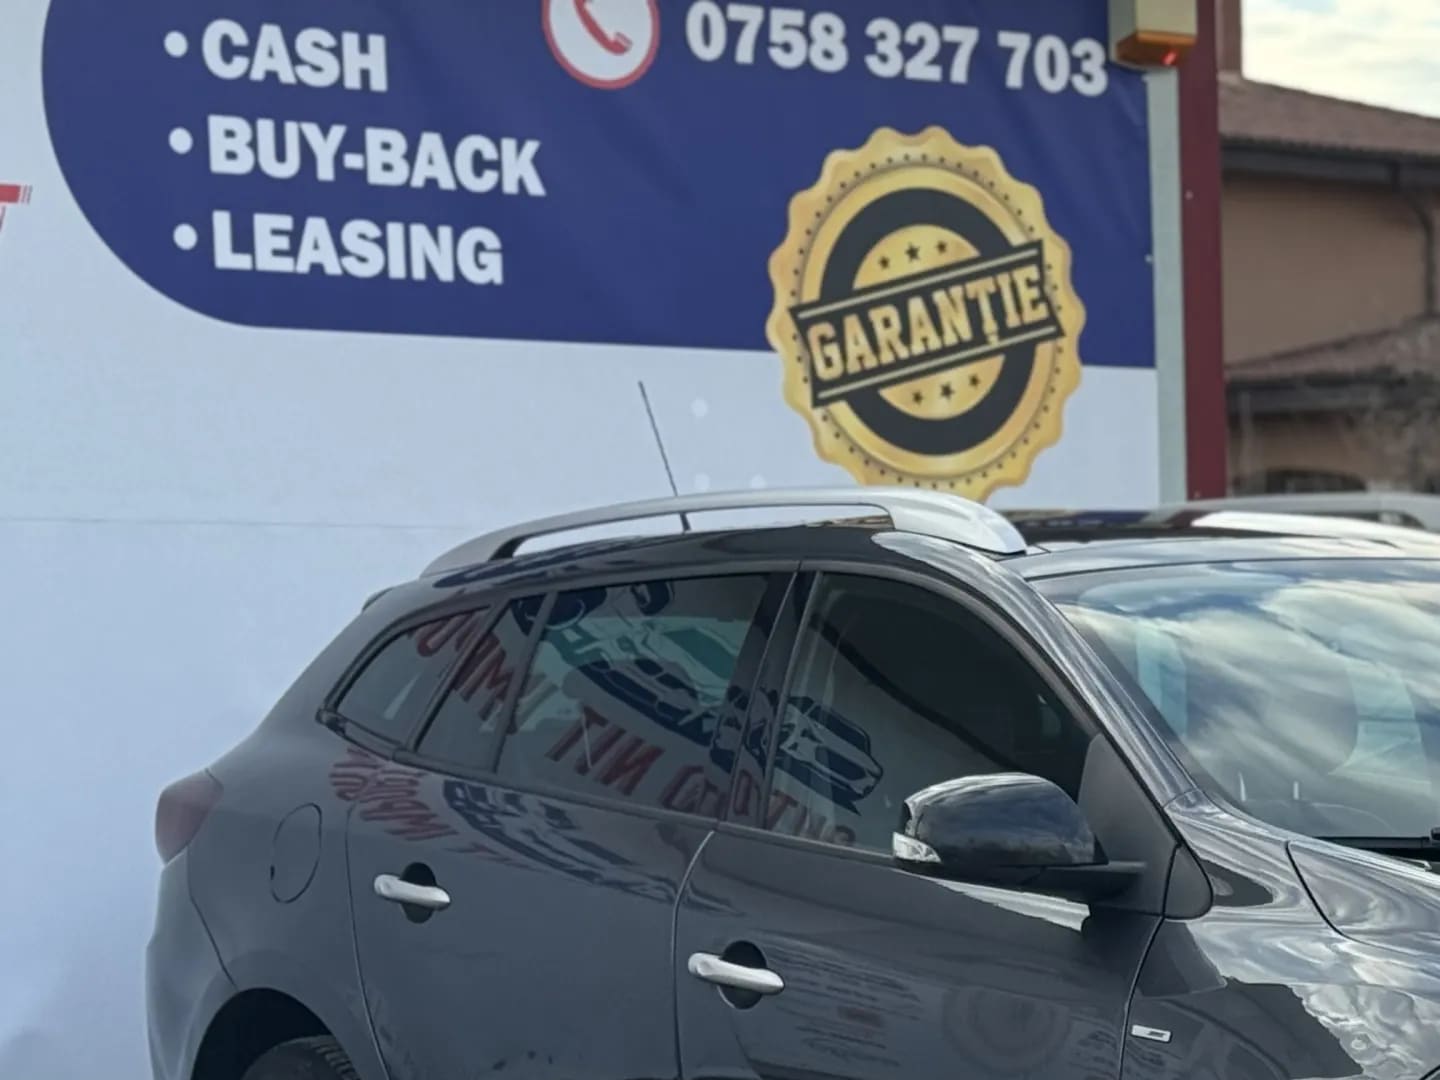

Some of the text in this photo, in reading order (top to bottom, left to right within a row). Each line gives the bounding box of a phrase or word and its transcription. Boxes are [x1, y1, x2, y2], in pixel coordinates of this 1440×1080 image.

[202, 19, 388, 92] CASH
[687, 1, 1107, 96] 0758 327 703
[208, 114, 547, 196] BUY-BACK
[212, 210, 503, 285] LEASING
